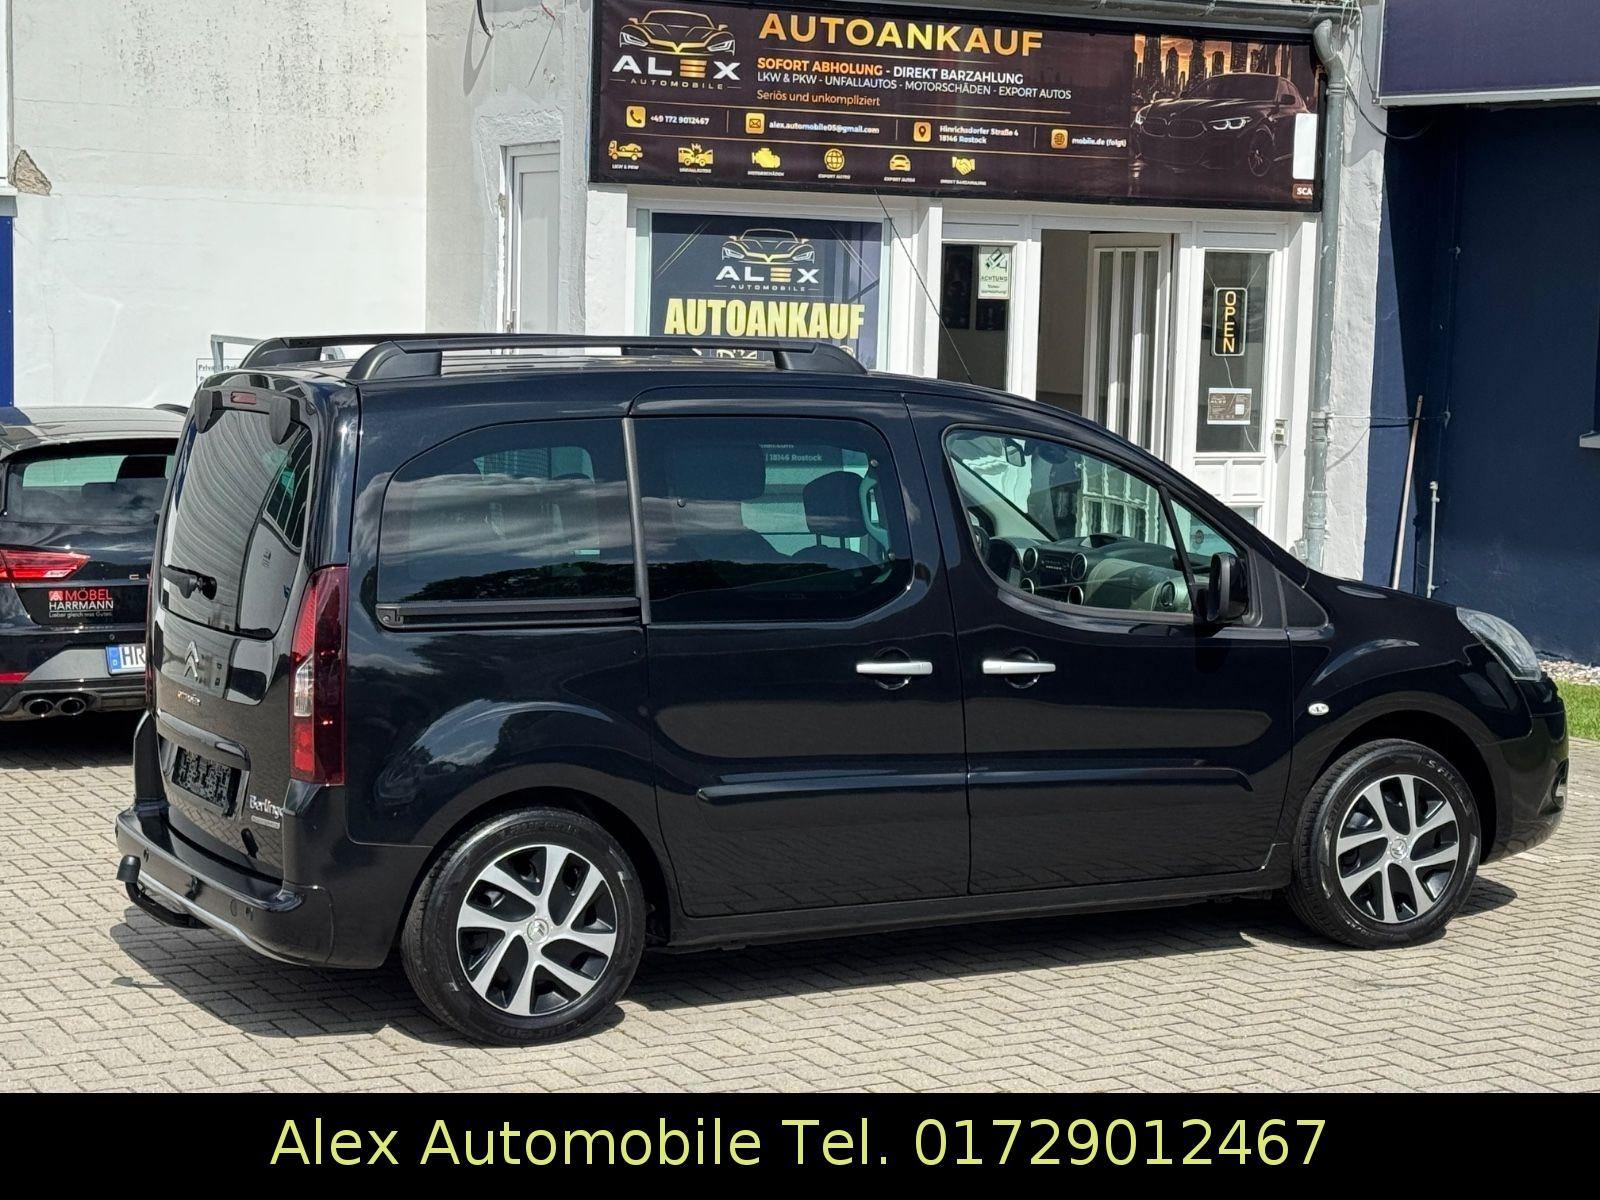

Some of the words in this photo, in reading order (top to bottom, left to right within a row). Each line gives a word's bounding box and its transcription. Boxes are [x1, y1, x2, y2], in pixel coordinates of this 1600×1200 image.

[758, 12, 1043, 57] AUTOANKAUF
[611, 54, 741, 81] ALEX
[757, 57, 809, 71] SOFORT
[812, 61, 883, 76] ABHOLUNG
[893, 66, 938, 80] DIREKT
[940, 69, 1024, 85] BARZAHLUNG
[630, 78, 724, 91] AUTOMOBILE
[757, 72, 781, 83] LKW
[783, 74, 790, 83] &
[792, 74, 817, 85] PKW
[825, 76, 897, 90] UNFALLAUTOS
[905, 80, 991, 96] MOTORSCHÄDEN
[999, 86, 1038, 98] EXPORT
[1039, 89, 1072, 100] AUTOS
[756, 89, 787, 101] Seriös
[789, 92, 809, 103] und
[811, 94, 881, 107] unkompliziert
[650, 115, 663, 123] +49
[665, 115, 677, 124] 172
[678, 116, 710, 126] 9012467
[769, 120, 880, 134] alex.automobile05@gmail.com
[940, 125, 990, 136] Hinrichsdorfer
[991, 128, 1013, 137] Straße
[958, 135, 987, 144] Rostock
[715, 265, 820, 285] ALEX
[730, 283, 806, 292] AUTOMOBILE
[664, 297, 866, 341] AUTOANKAUF
[1223, 290, 1237, 353] OPEN
[791, 453, 823, 462] Rostock
[65, 588, 113, 601] MÖBEL
[48, 600, 114, 611] HARRMANN
